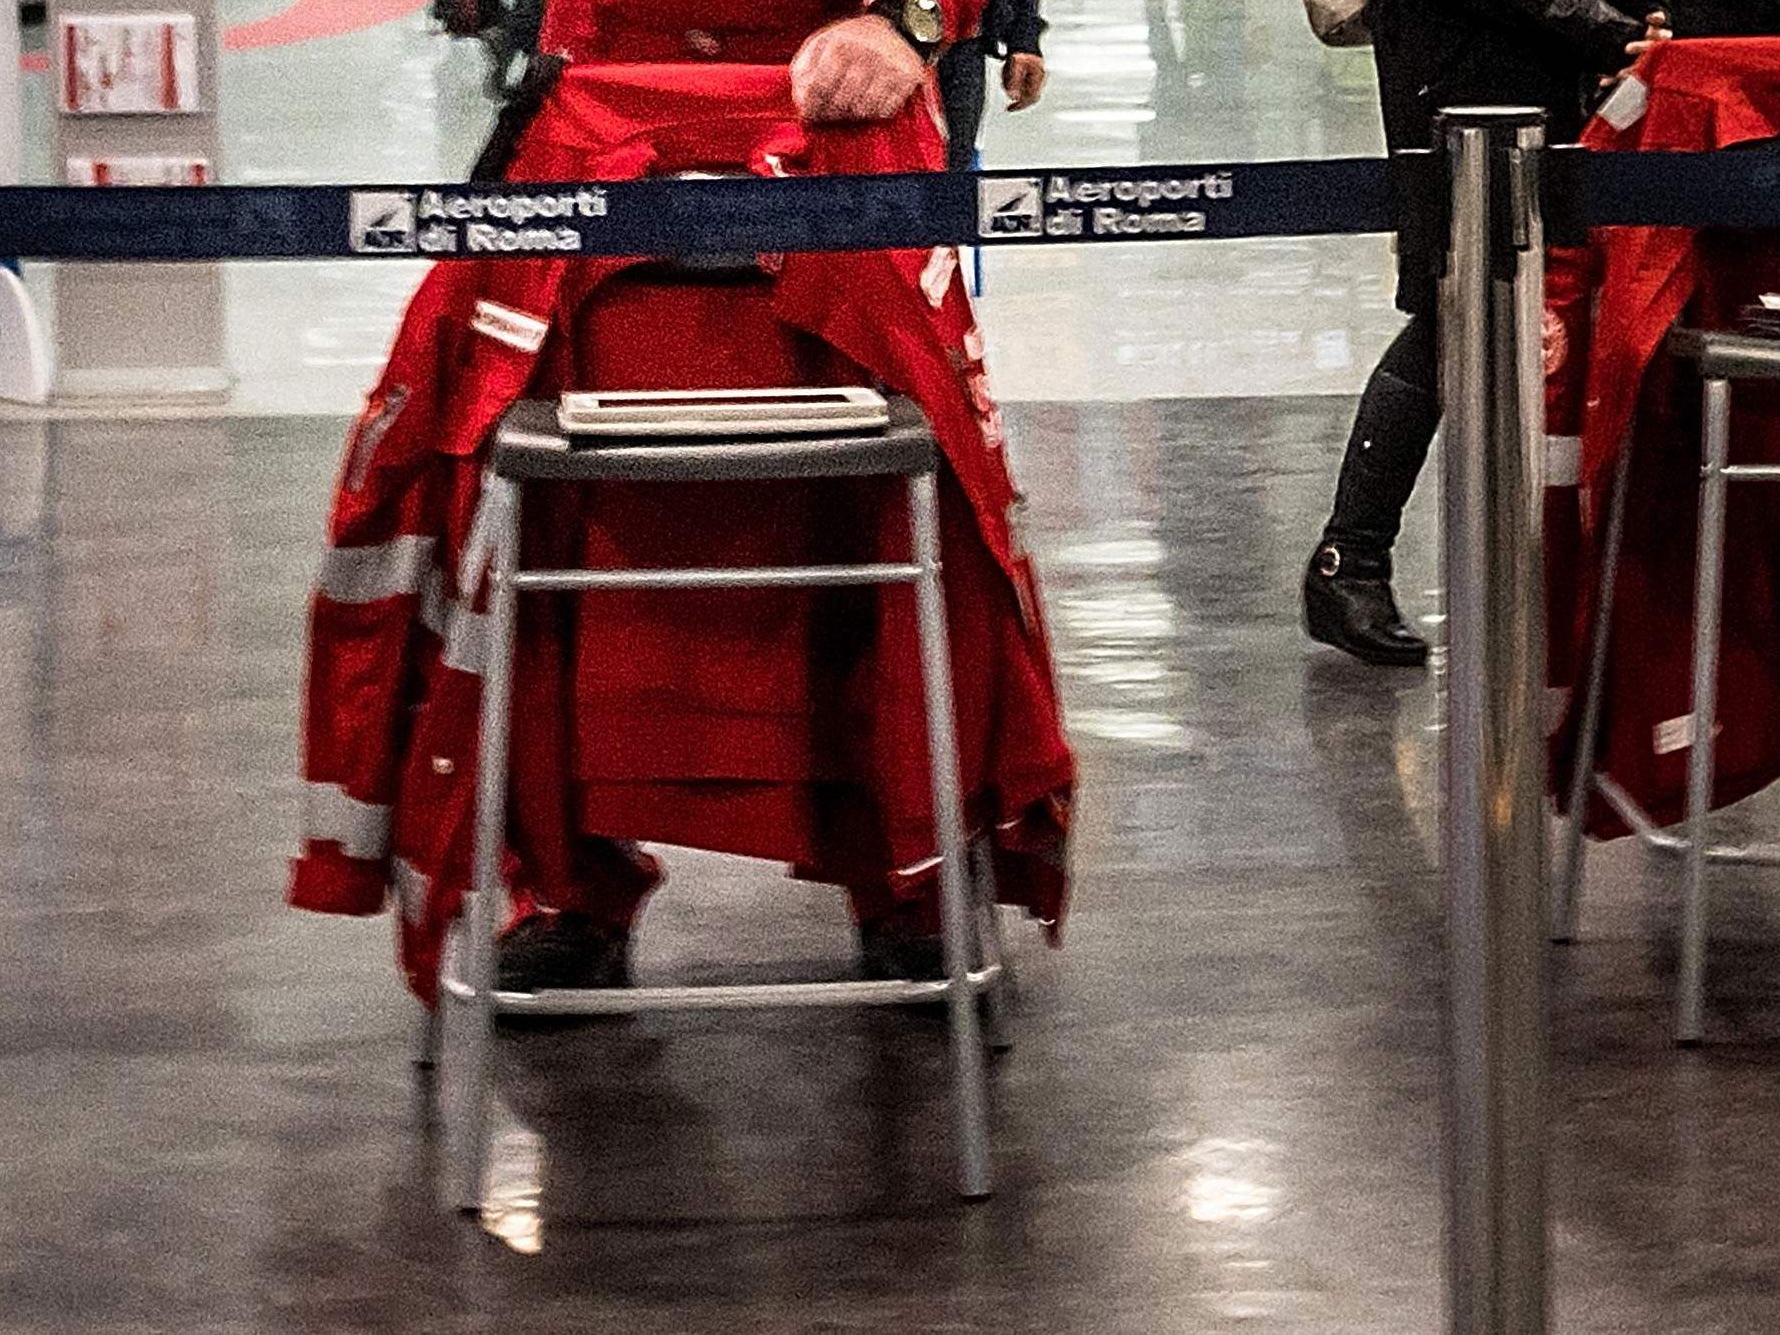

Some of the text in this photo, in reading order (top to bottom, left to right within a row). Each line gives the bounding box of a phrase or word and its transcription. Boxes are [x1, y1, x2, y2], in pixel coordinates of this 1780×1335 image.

[1046, 171, 1233, 207] Aeroporti
[418, 187, 608, 225] Aeroporti
[1046, 207, 1206, 236] di Roma
[418, 223, 458, 253] di
[466, 222, 582, 253] Roma
